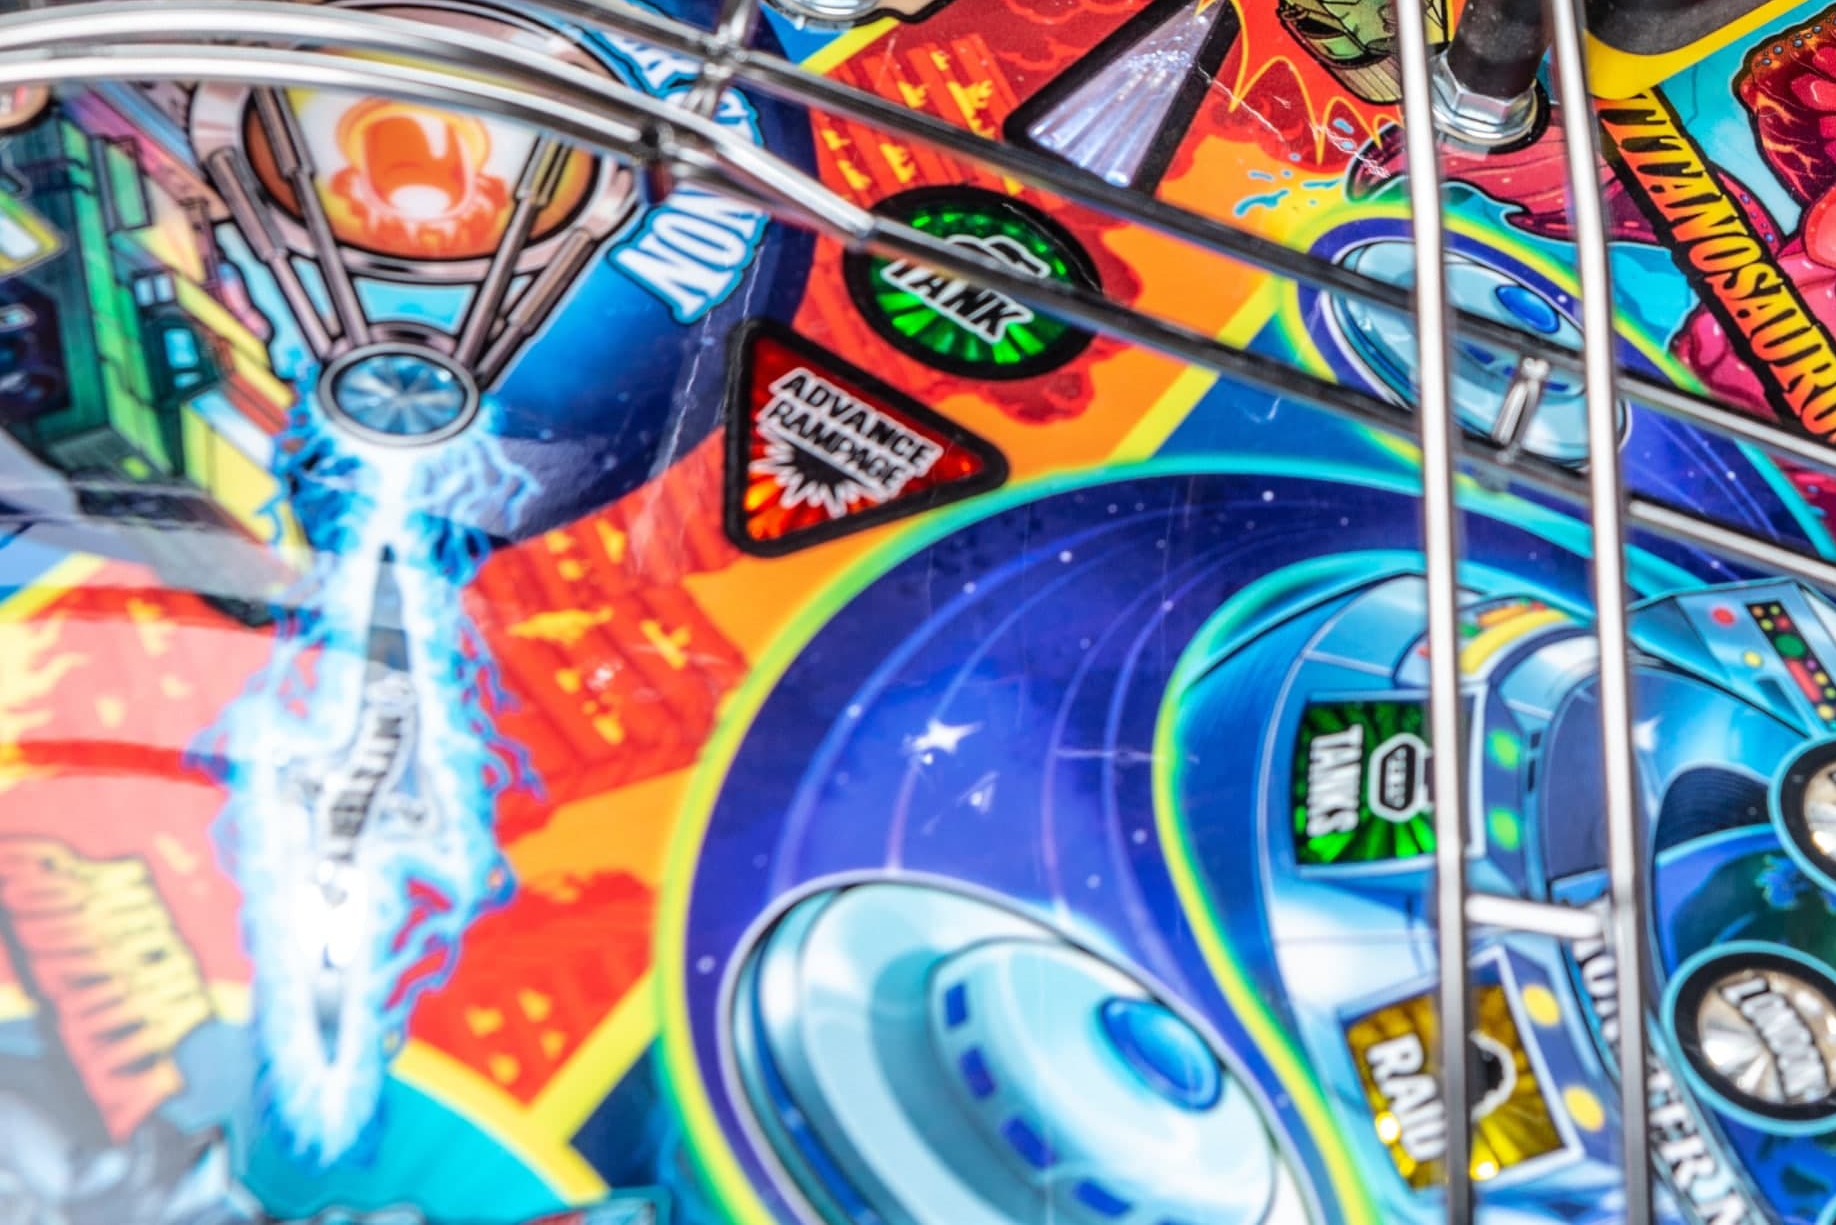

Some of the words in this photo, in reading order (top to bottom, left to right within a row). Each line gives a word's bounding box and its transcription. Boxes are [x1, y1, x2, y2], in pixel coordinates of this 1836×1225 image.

[765, 399, 906, 487] RAMPAGE
[779, 373, 937, 465] ADVANCE
[1306, 724, 1364, 837] TANKS
